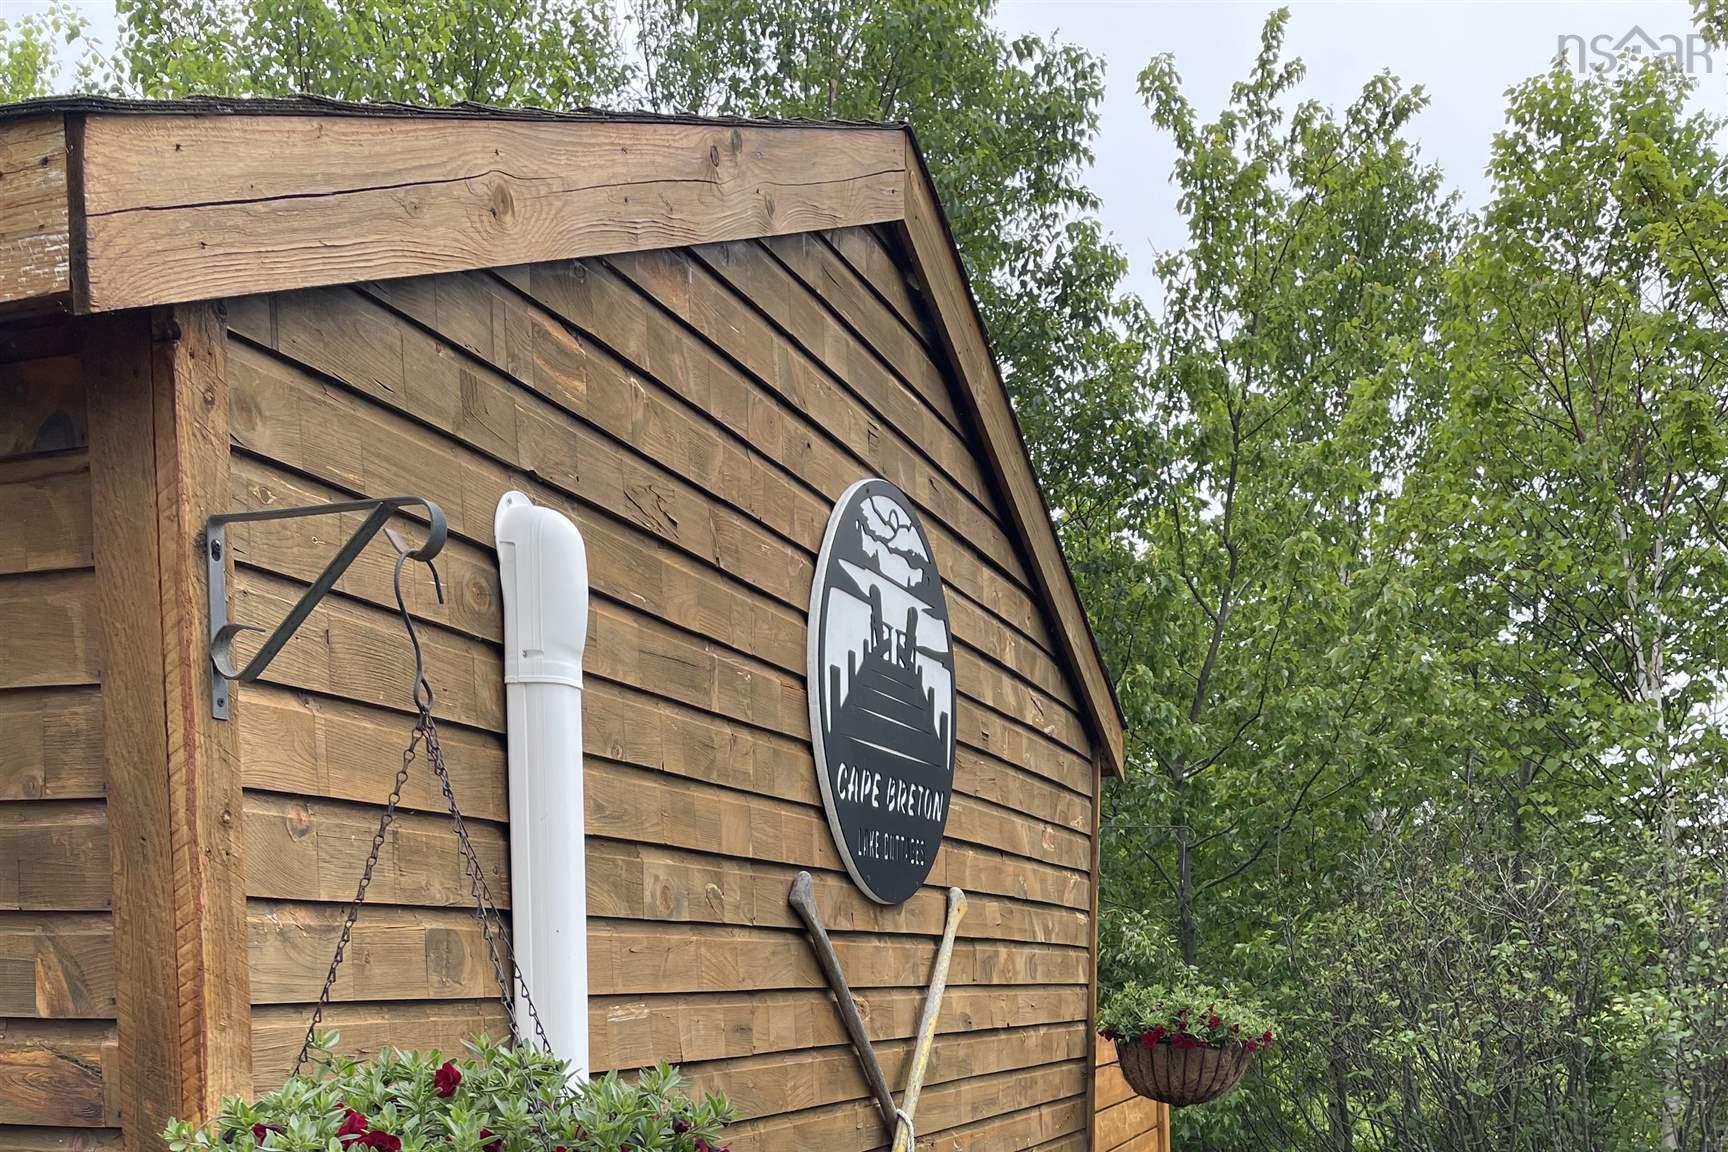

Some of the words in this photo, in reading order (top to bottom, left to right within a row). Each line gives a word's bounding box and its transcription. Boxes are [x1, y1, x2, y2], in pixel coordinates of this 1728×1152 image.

[837, 762, 881, 808] CAPE
[886, 777, 944, 822] BRETON
[858, 827, 880, 859] LAKE
